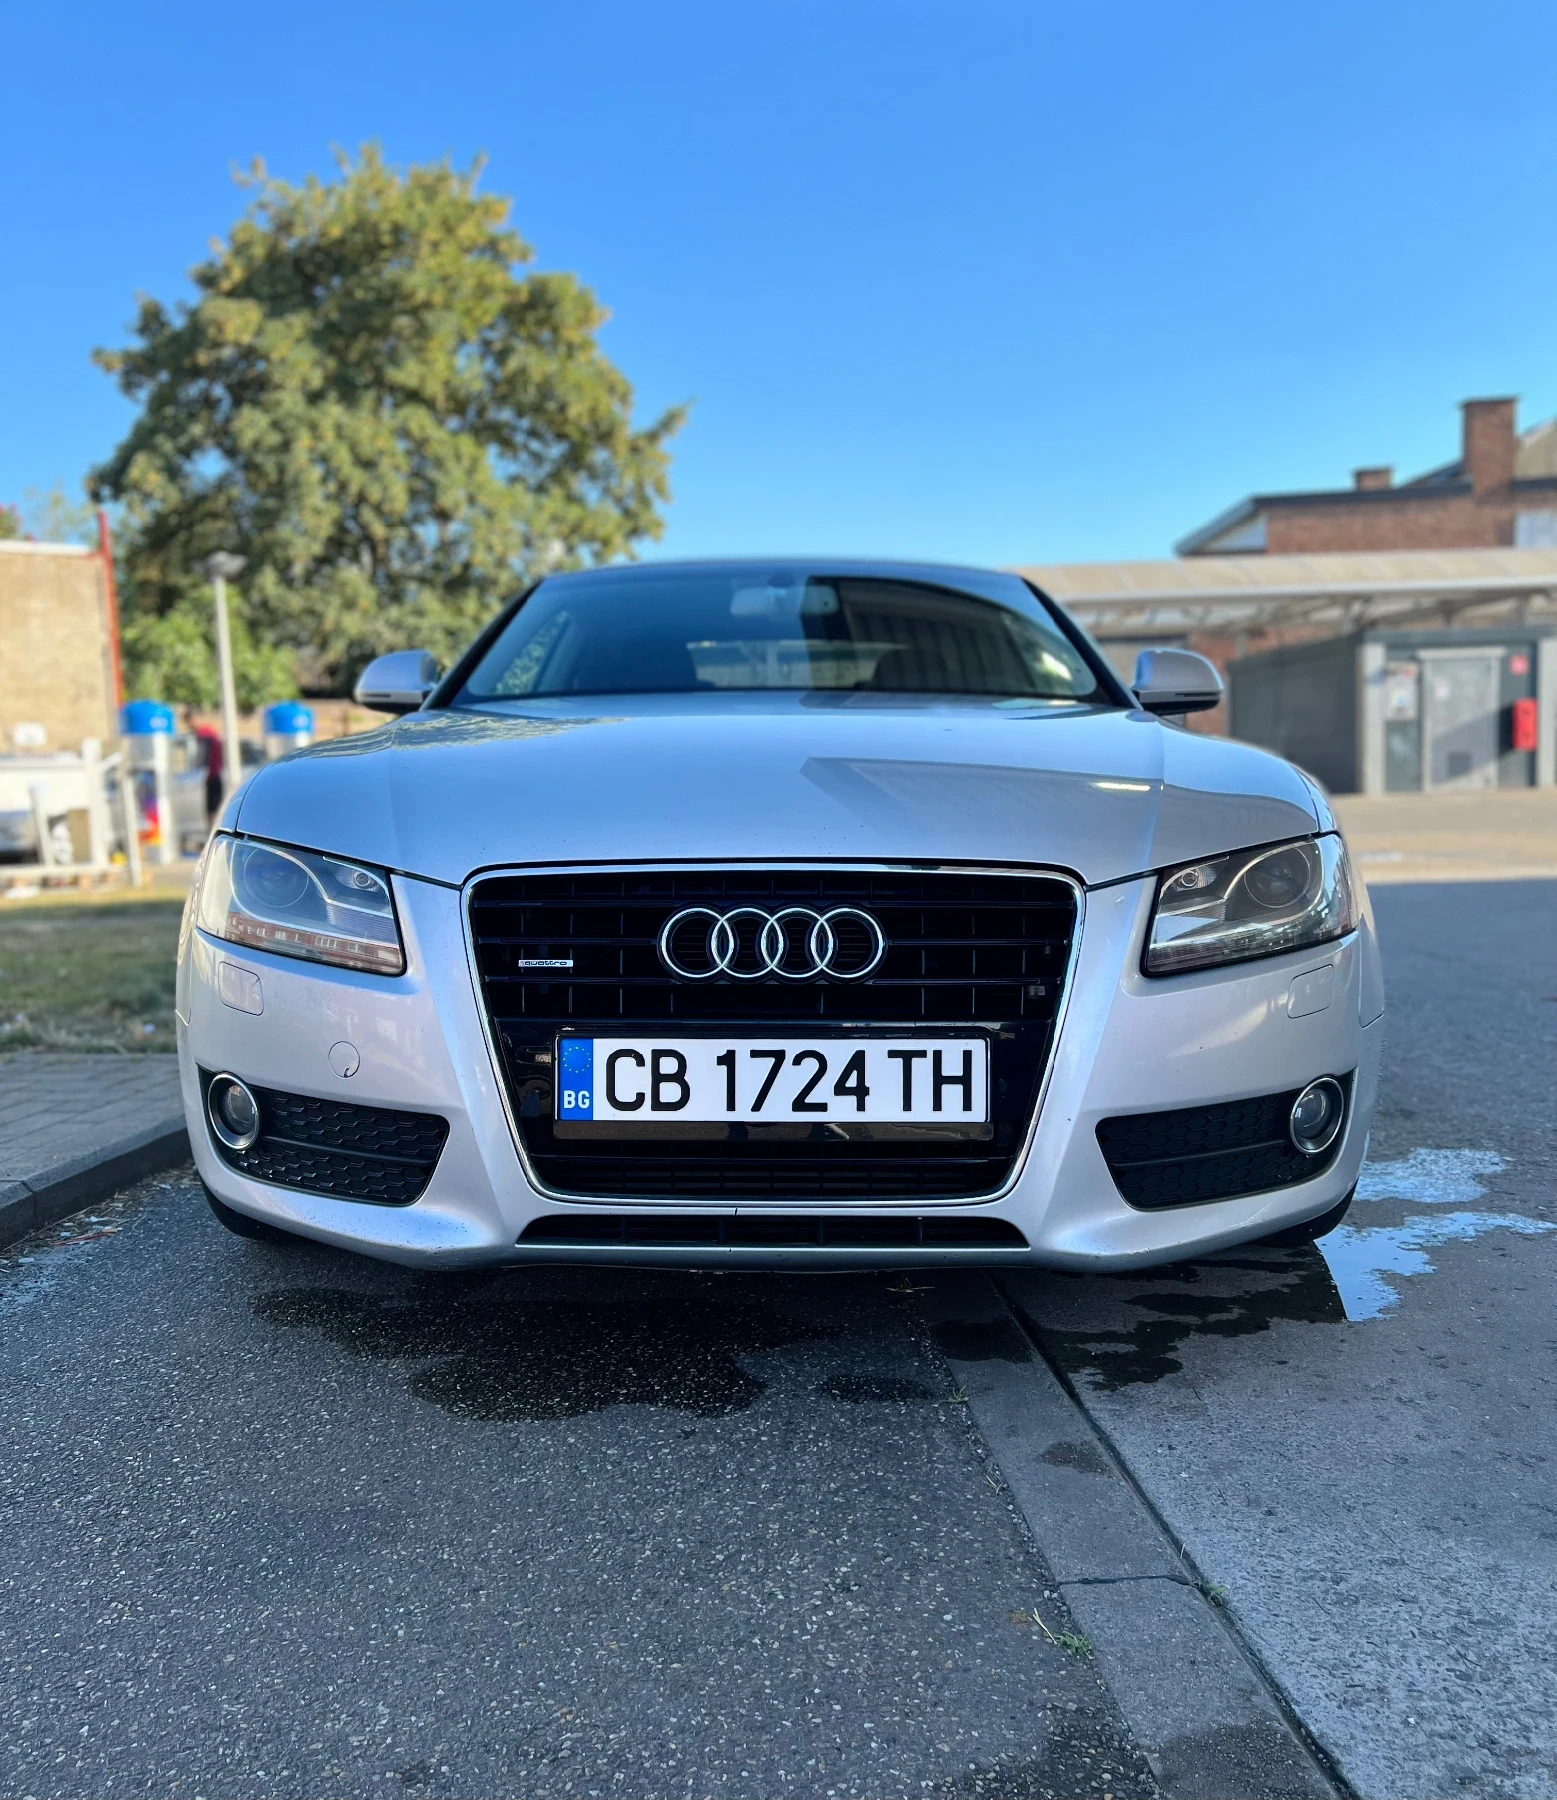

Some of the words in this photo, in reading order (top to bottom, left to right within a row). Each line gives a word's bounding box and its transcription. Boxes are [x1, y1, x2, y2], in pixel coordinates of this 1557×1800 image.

[563, 1090, 590, 1109] BG
[605, 1048, 691, 1112] CB
[716, 1049, 870, 1112] 1724
[887, 1049, 973, 1112] TH
